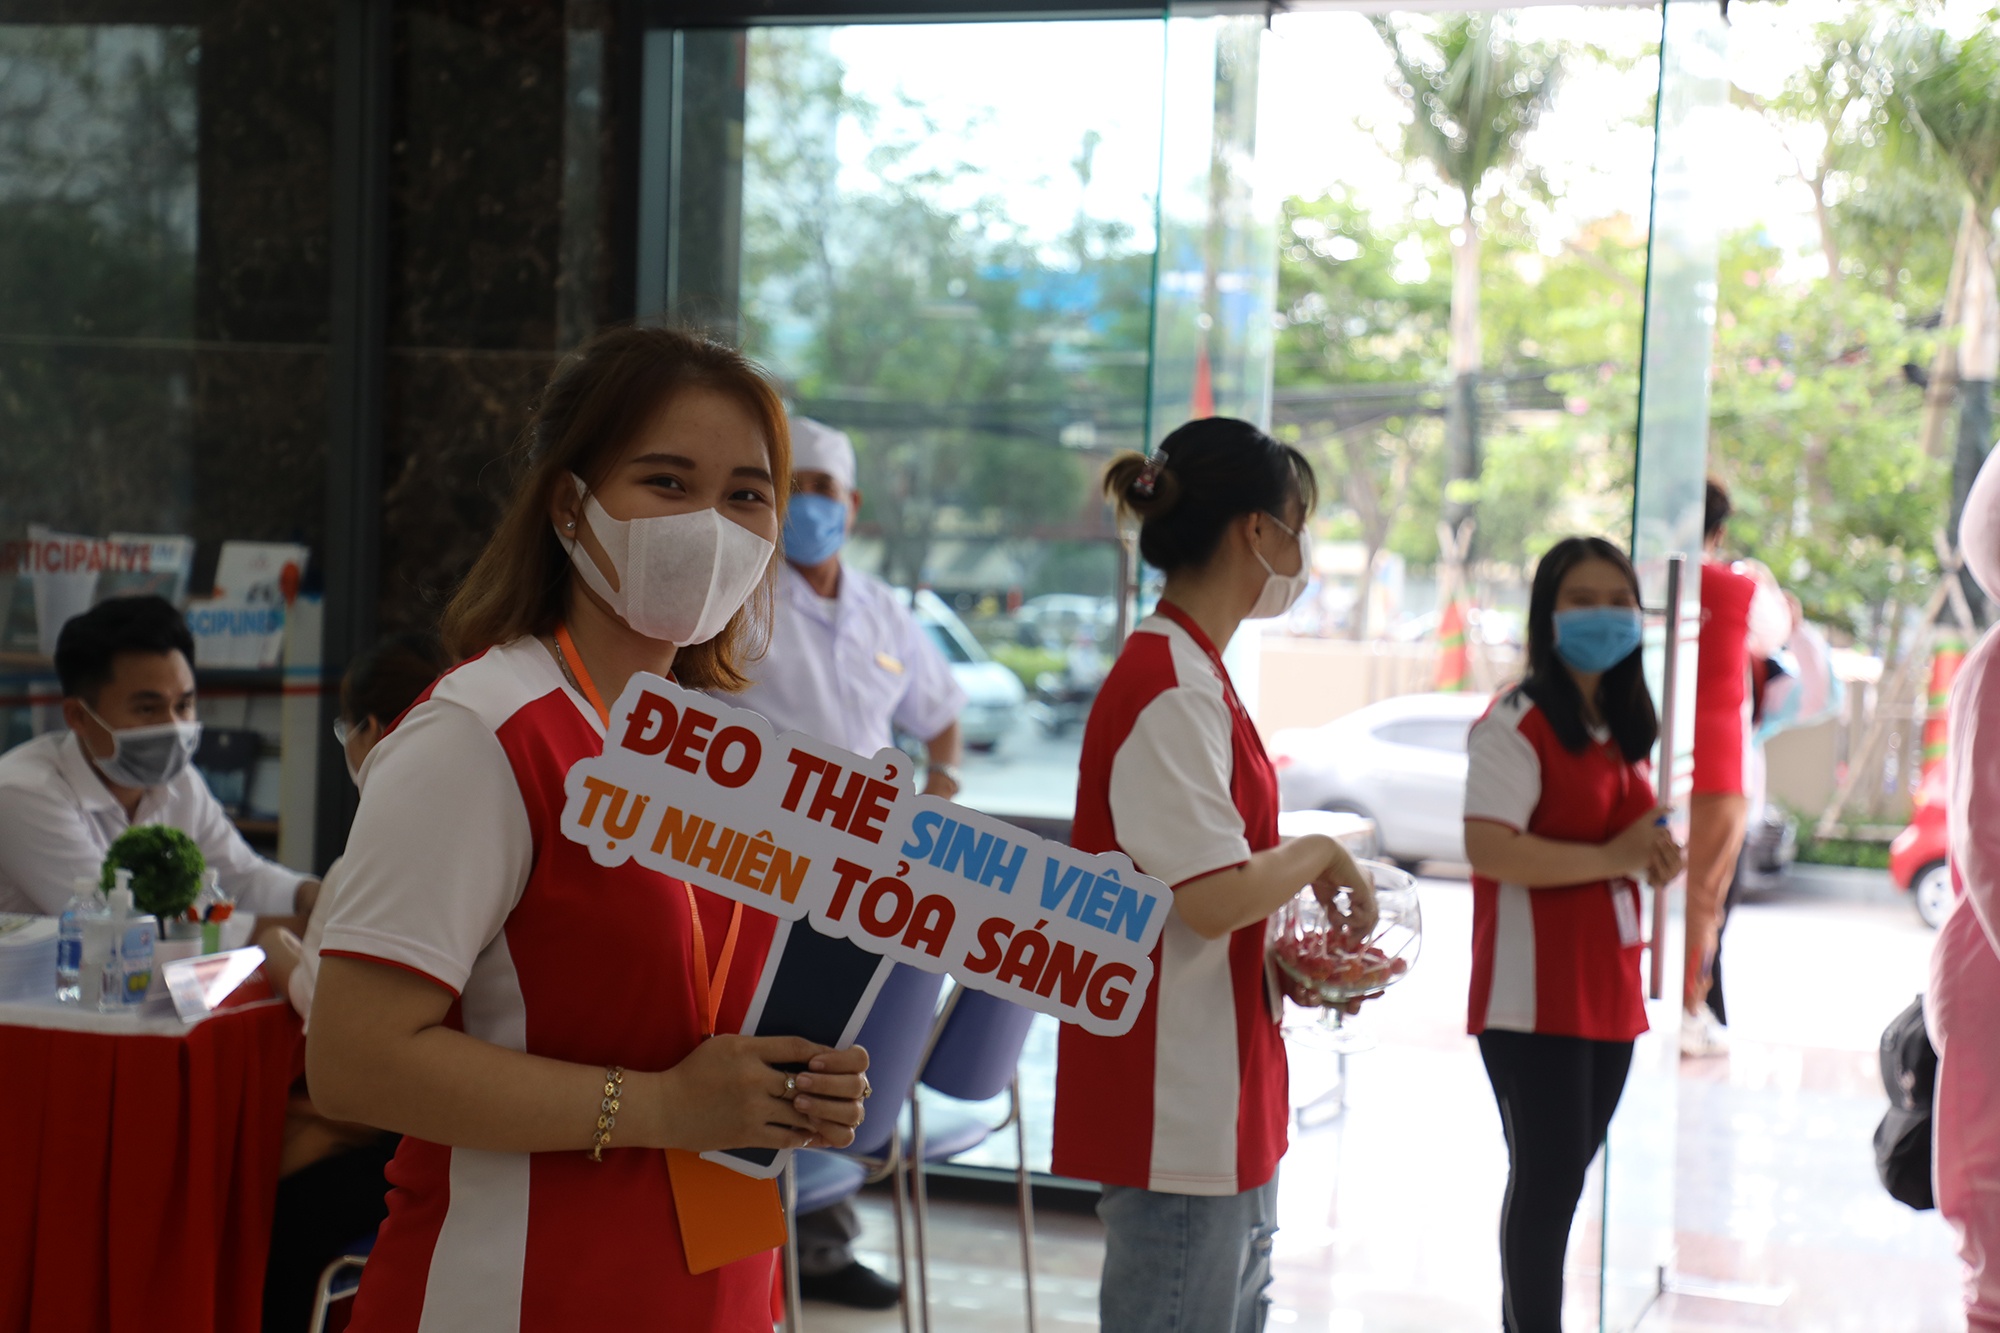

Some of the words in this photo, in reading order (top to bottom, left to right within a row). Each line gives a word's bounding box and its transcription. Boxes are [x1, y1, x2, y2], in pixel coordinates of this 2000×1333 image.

[577, 775, 651, 851] TỰ
[650, 805, 812, 905] NHIÊN
[825, 857, 956, 958] TỎA
[963, 917, 1137, 1021] SÁNG
[621, 689, 762, 789] ĐEO
[781, 747, 899, 844] THẺ
[901, 811, 1028, 894] SINH
[1040, 857, 1157, 943] VIÊN
